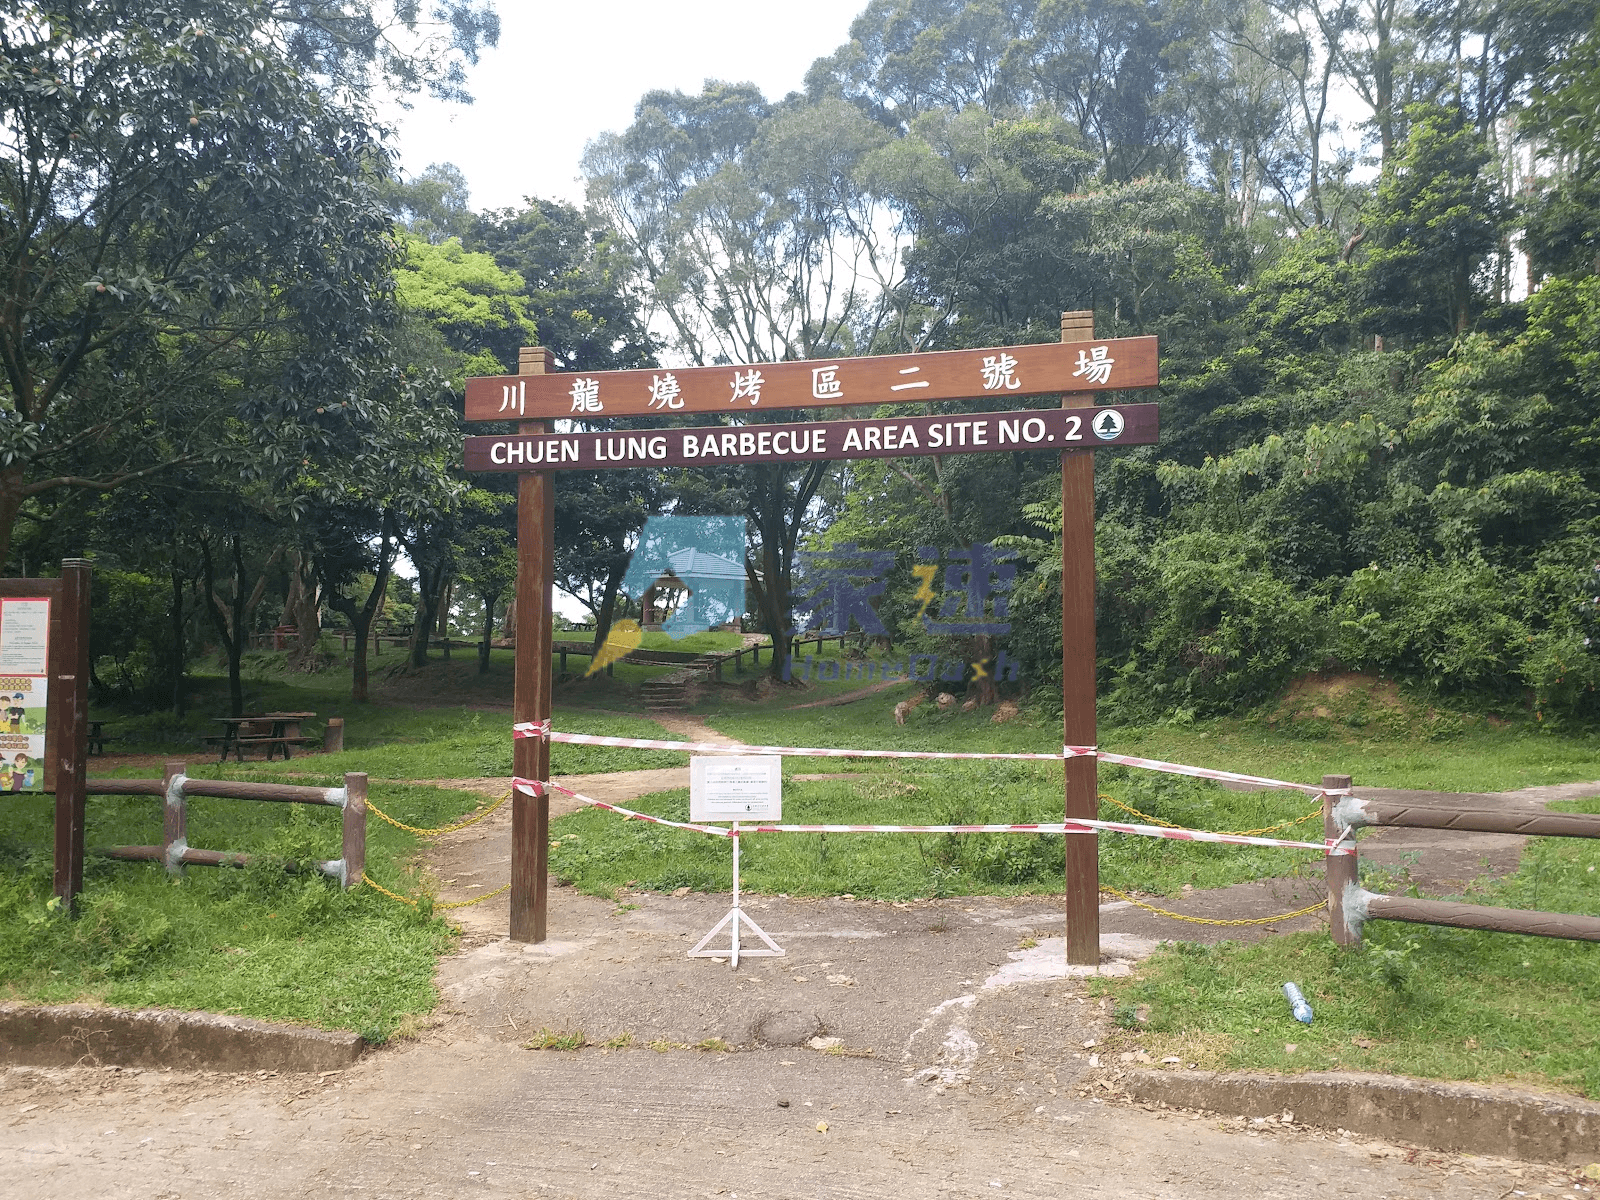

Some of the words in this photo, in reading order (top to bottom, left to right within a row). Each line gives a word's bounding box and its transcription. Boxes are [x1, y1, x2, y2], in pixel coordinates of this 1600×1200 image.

[498, 346, 1115, 416] 川龍燒烤區二號場
[490, 439, 579, 464] CHUEN
[595, 436, 667, 461] LUNG
[683, 429, 827, 458] BARBECUE
[842, 425, 919, 452] AREA
[928, 420, 988, 447] SITE
[998, 417, 1055, 444] NO.
[1065, 416, 1083, 440] 2
